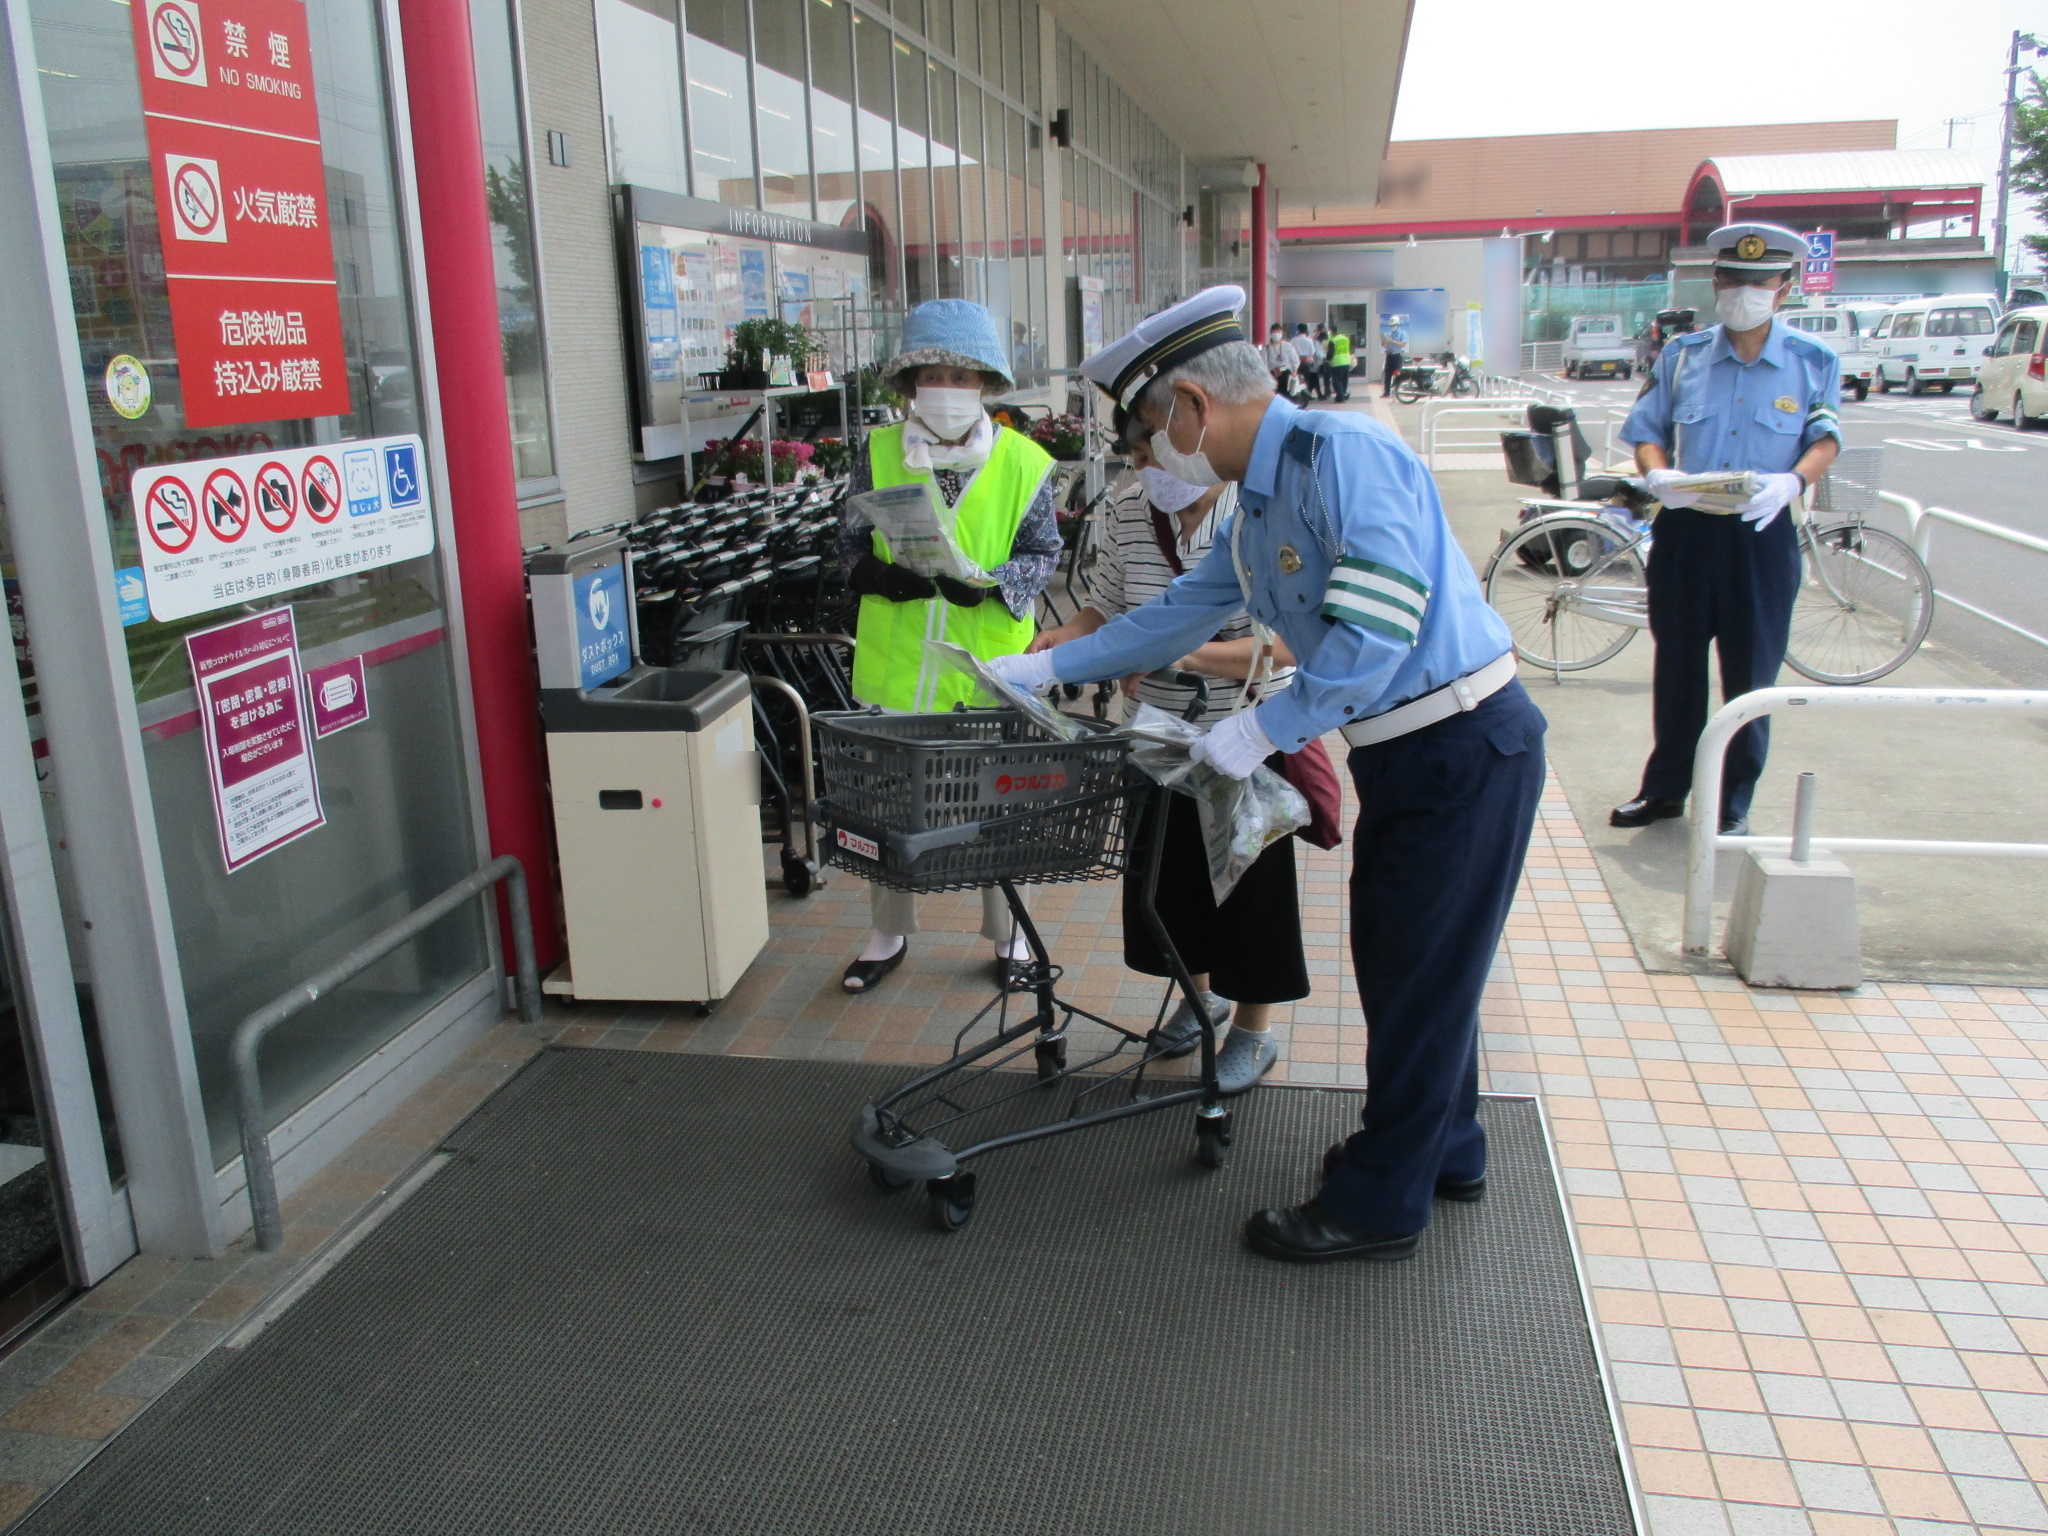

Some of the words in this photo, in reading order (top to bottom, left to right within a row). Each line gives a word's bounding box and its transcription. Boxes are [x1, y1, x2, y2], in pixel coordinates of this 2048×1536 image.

[219, 66, 240, 86] NO
[246, 73, 302, 100] SMOKING
[233, 187, 319, 228] 火気厳禁
[729, 209, 812, 244] INFORMATION
[218, 310, 308, 347] 危険物品
[213, 358, 323, 397] 持込み厳禁
[351, 500, 381, 514] ほじょ犬
[581, 630, 625, 663] ダストボックス
[591, 659, 605, 675] DUST
[608, 652, 619, 666] BOX
[230, 698, 284, 729] を避ける為に
[1013, 773, 1067, 791] マルナカ
[849, 837, 878, 857] マルナカ
